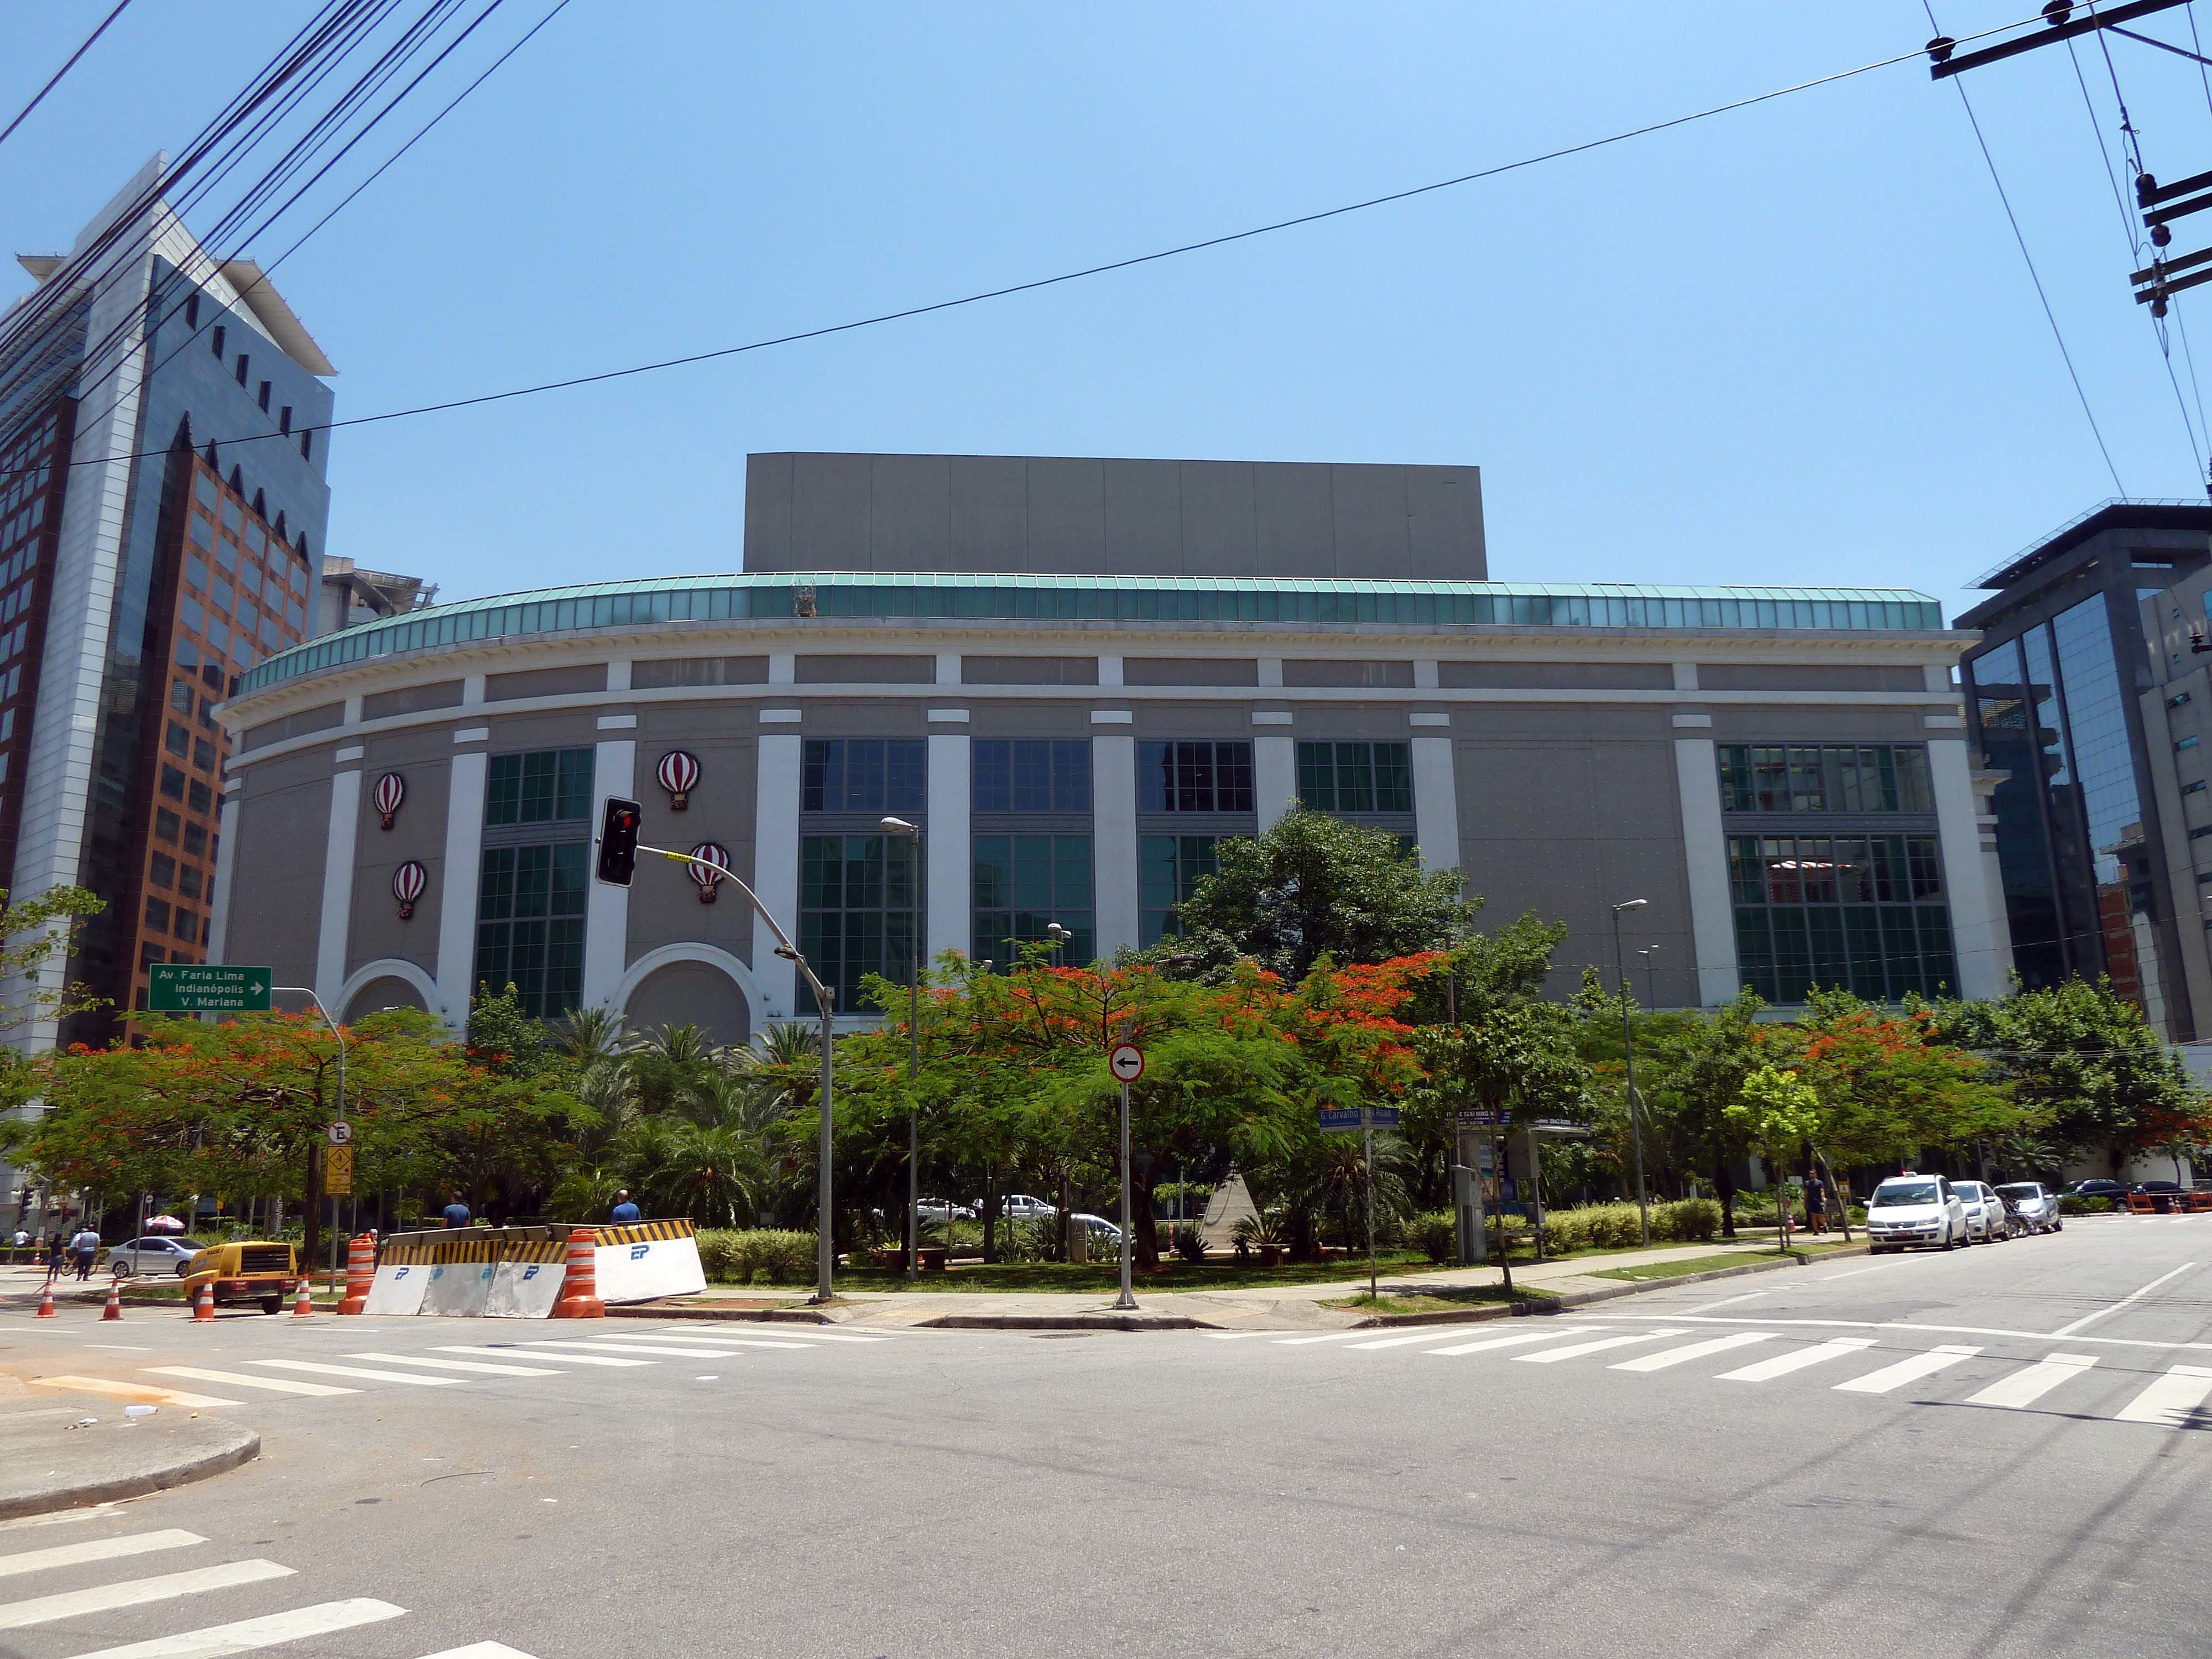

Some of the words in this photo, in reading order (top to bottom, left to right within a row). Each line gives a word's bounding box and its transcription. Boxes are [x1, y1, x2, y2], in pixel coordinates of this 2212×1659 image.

[159, 971, 177, 979] Av.
[181, 971, 212, 980] Faria
[216, 972, 244, 980] Lima
[175, 983, 244, 994] Indianópolis
[181, 997, 193, 1006] V.
[197, 997, 244, 1006] Mariana
[1328, 1109, 1359, 1119] Carvalho
